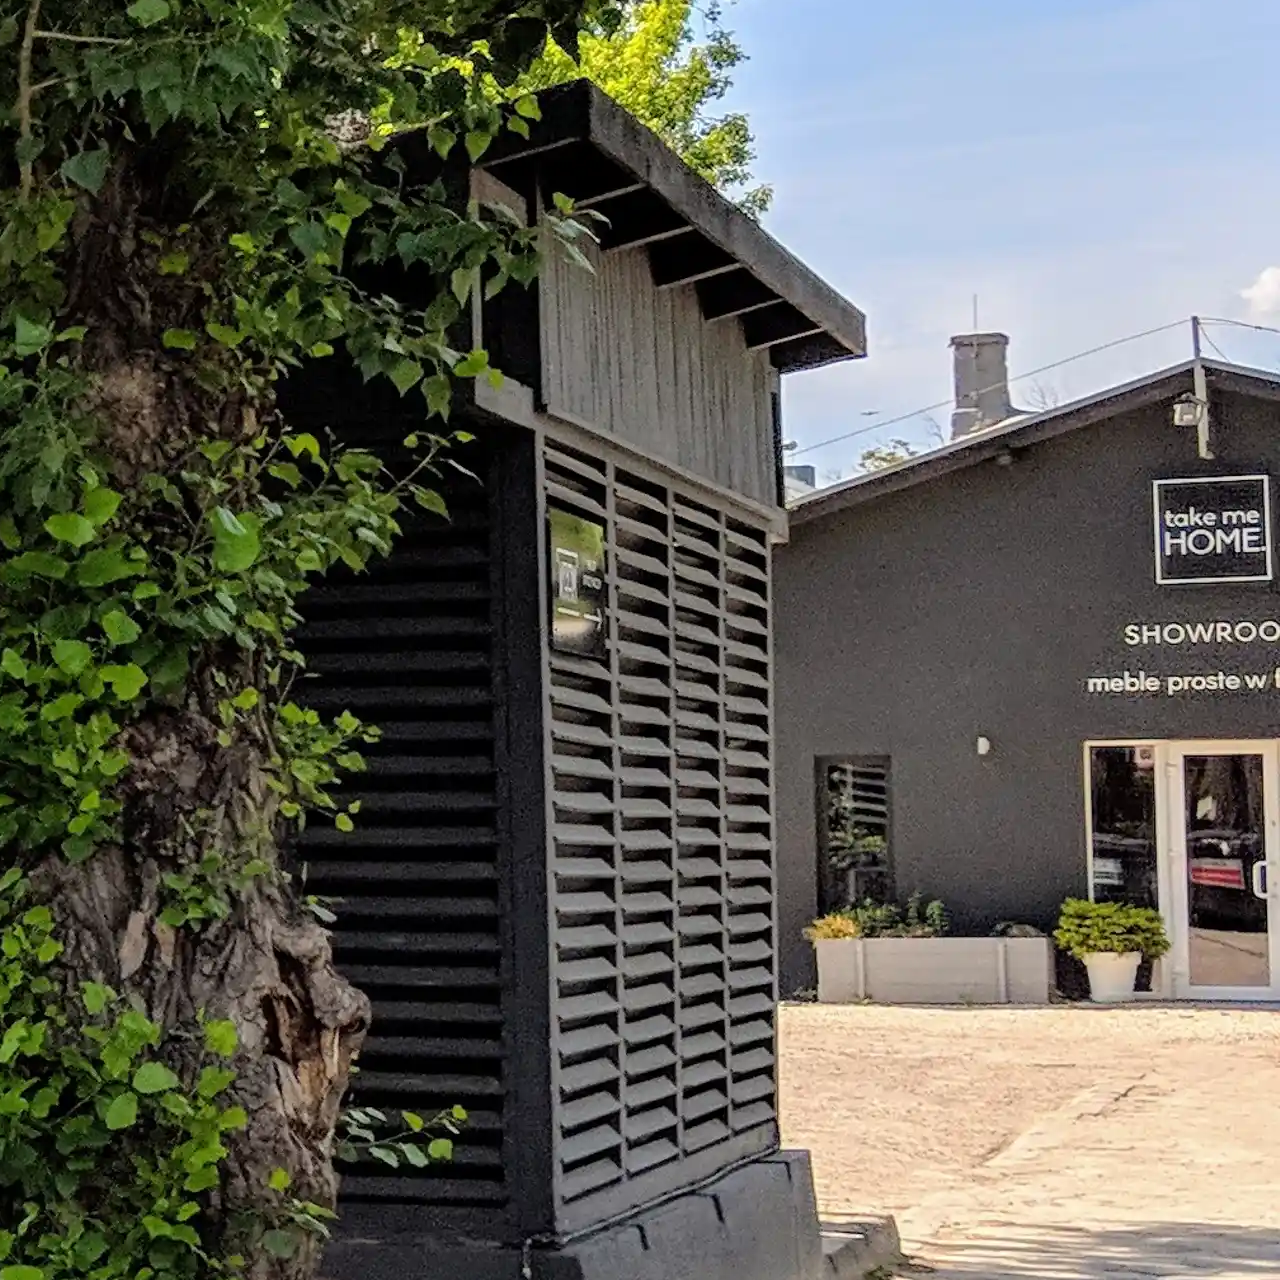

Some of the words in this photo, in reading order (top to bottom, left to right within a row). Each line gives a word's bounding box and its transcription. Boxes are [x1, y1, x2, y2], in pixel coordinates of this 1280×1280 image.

[1164, 507, 1217, 528] take
[1222, 509, 1260, 525] me
[1088, 671, 1161, 694] meble
[1166, 671, 1241, 696] proste
[1243, 674, 1267, 689] w
